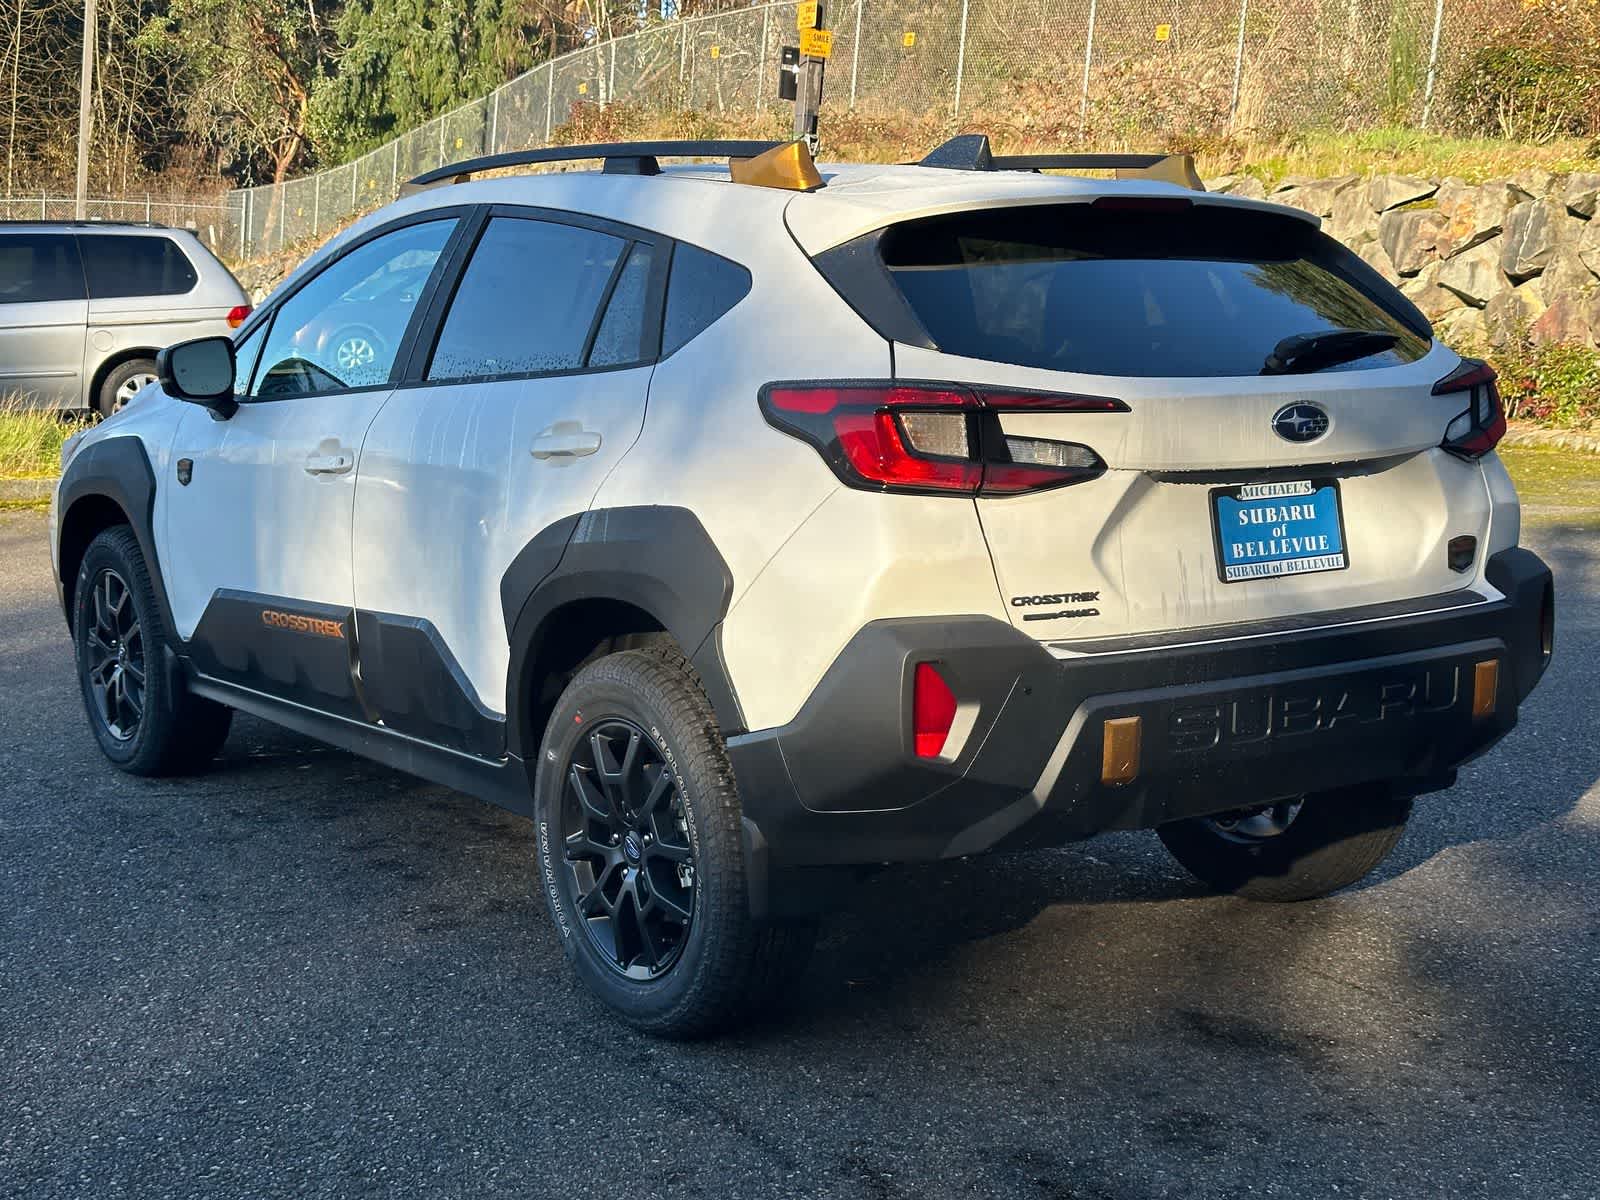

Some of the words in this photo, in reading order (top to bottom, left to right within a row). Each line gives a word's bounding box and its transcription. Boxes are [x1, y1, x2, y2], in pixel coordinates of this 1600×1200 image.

[1242, 481, 1311, 498] MICHAEL'S
[1239, 503, 1316, 525] SUBARU
[1272, 523, 1287, 538] of
[1232, 535, 1330, 559] BELLEVUE
[1226, 561, 1270, 579] SUBARU
[1273, 562, 1282, 573] of
[1287, 555, 1343, 572] BELLEVUE
[1011, 591, 1100, 607] CROSSTREK
[262, 610, 345, 639] CROSSTREK
[1170, 665, 1459, 752] SUBARU
[540, 822, 571, 938] YOKOHAMA
